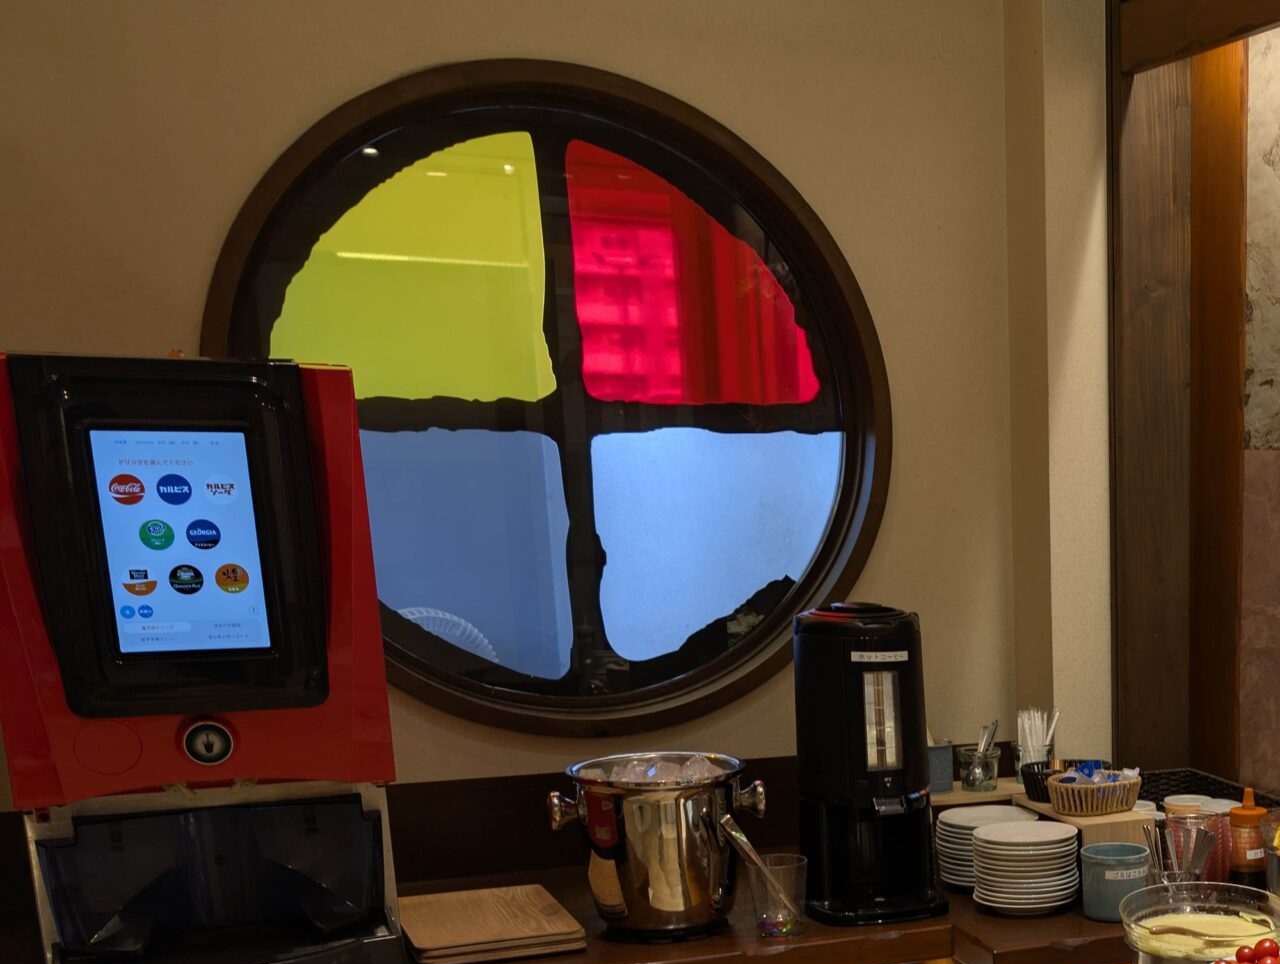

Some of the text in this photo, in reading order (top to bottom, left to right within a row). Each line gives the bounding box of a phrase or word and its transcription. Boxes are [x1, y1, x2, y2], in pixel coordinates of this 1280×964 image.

[159, 485, 190, 494] カルピス
[205, 482, 236, 491] カルピス
[210, 489, 233, 497] ソーダ
[189, 527, 217, 537] GEORGIA
